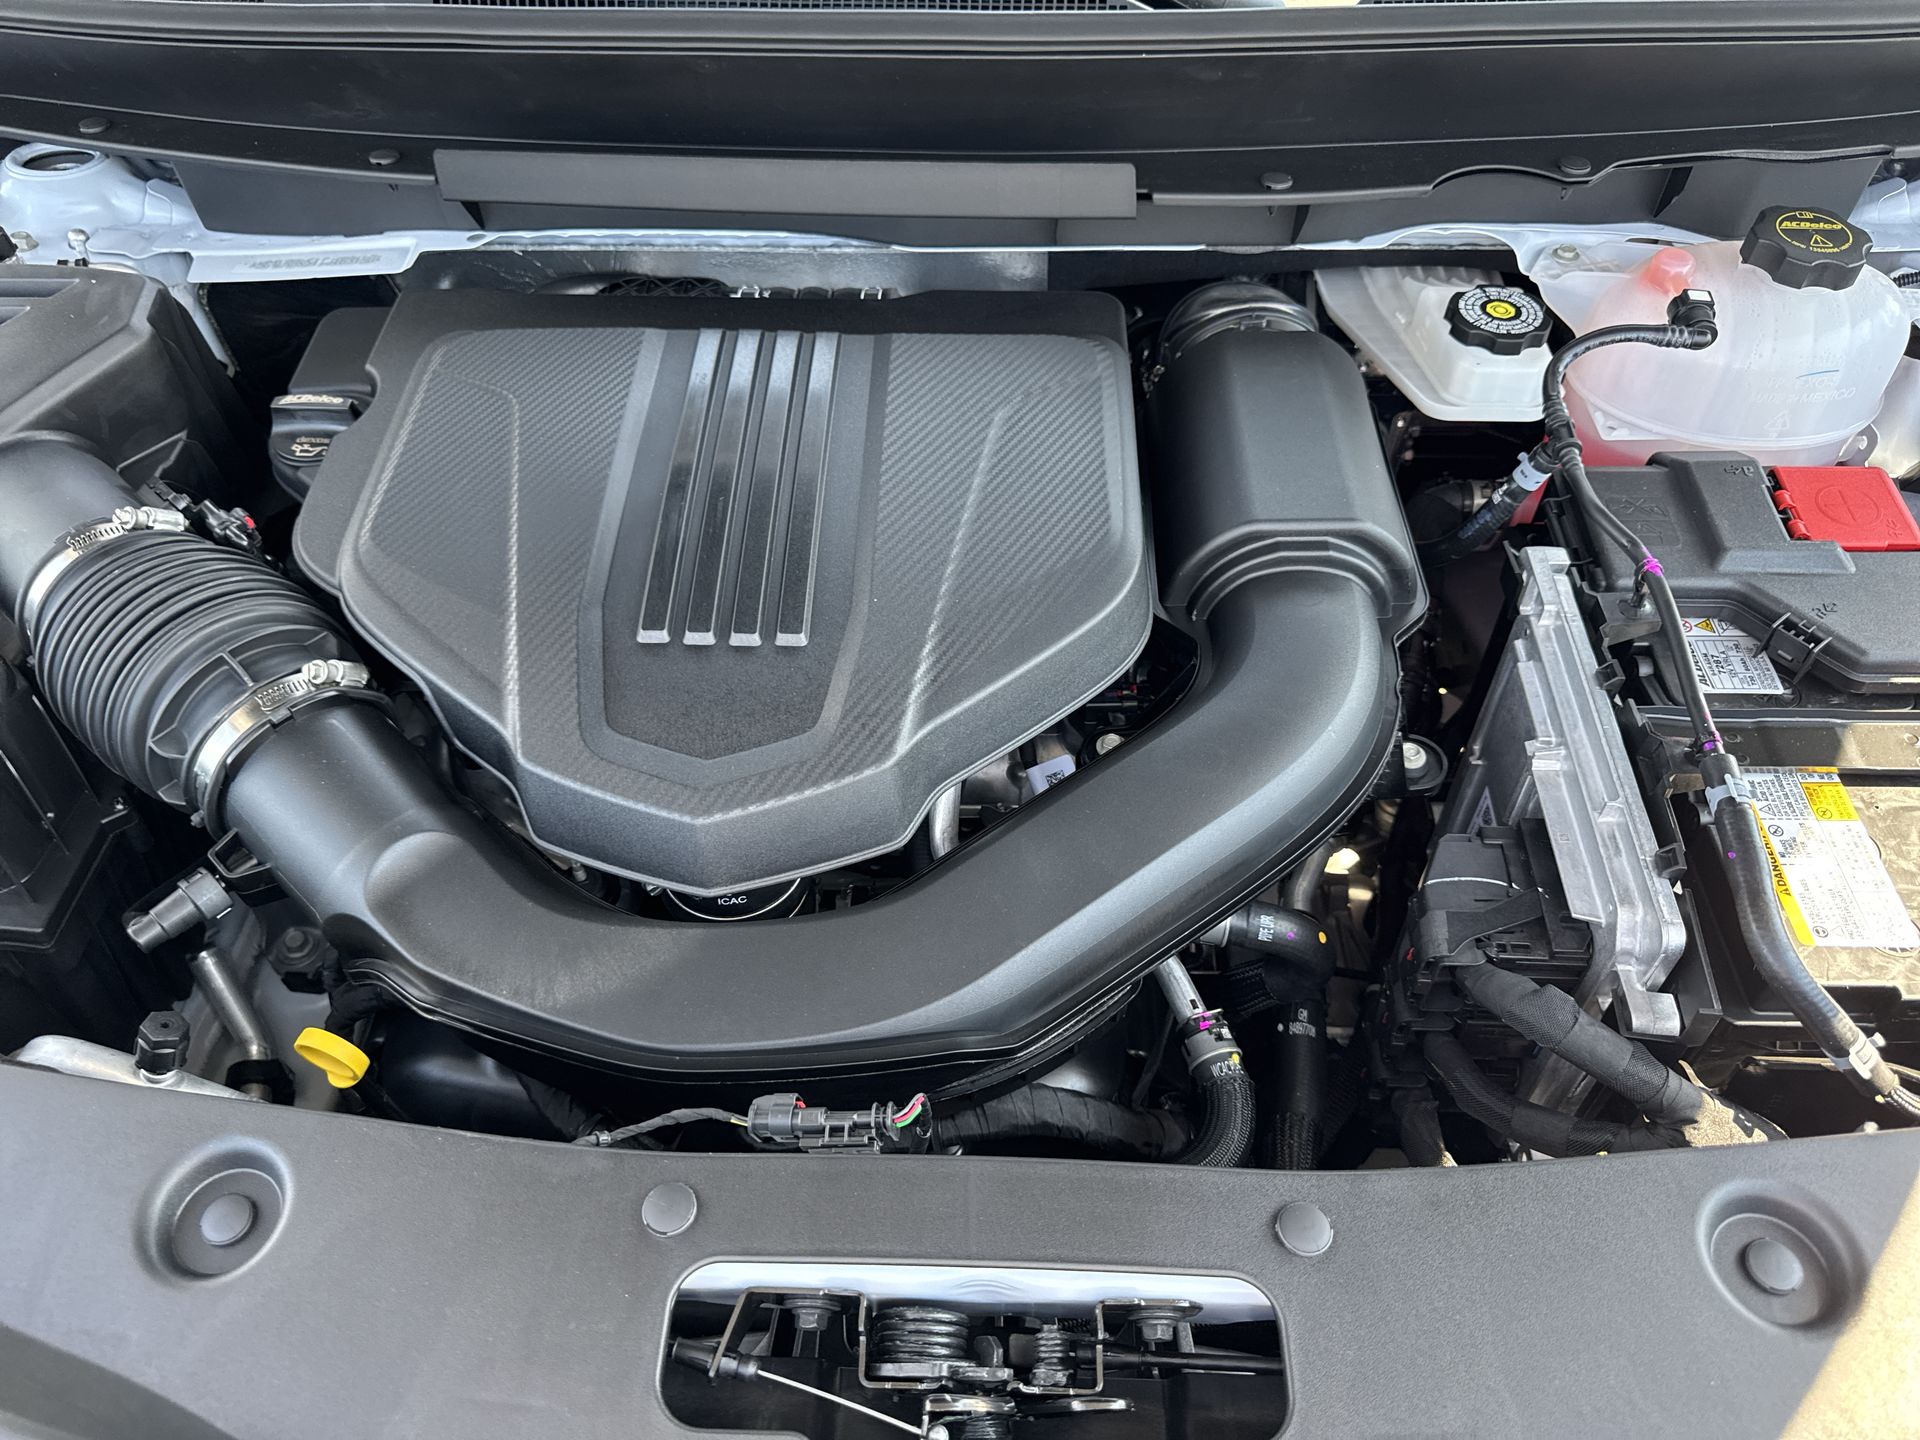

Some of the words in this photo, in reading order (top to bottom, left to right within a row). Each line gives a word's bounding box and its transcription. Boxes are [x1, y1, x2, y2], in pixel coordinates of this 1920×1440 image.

[1779, 220, 1842, 230] ACDelco
[278, 393, 344, 405] ACDelco
[1710, 653, 1726, 675] 7287
[717, 895, 748, 906] ICAC
